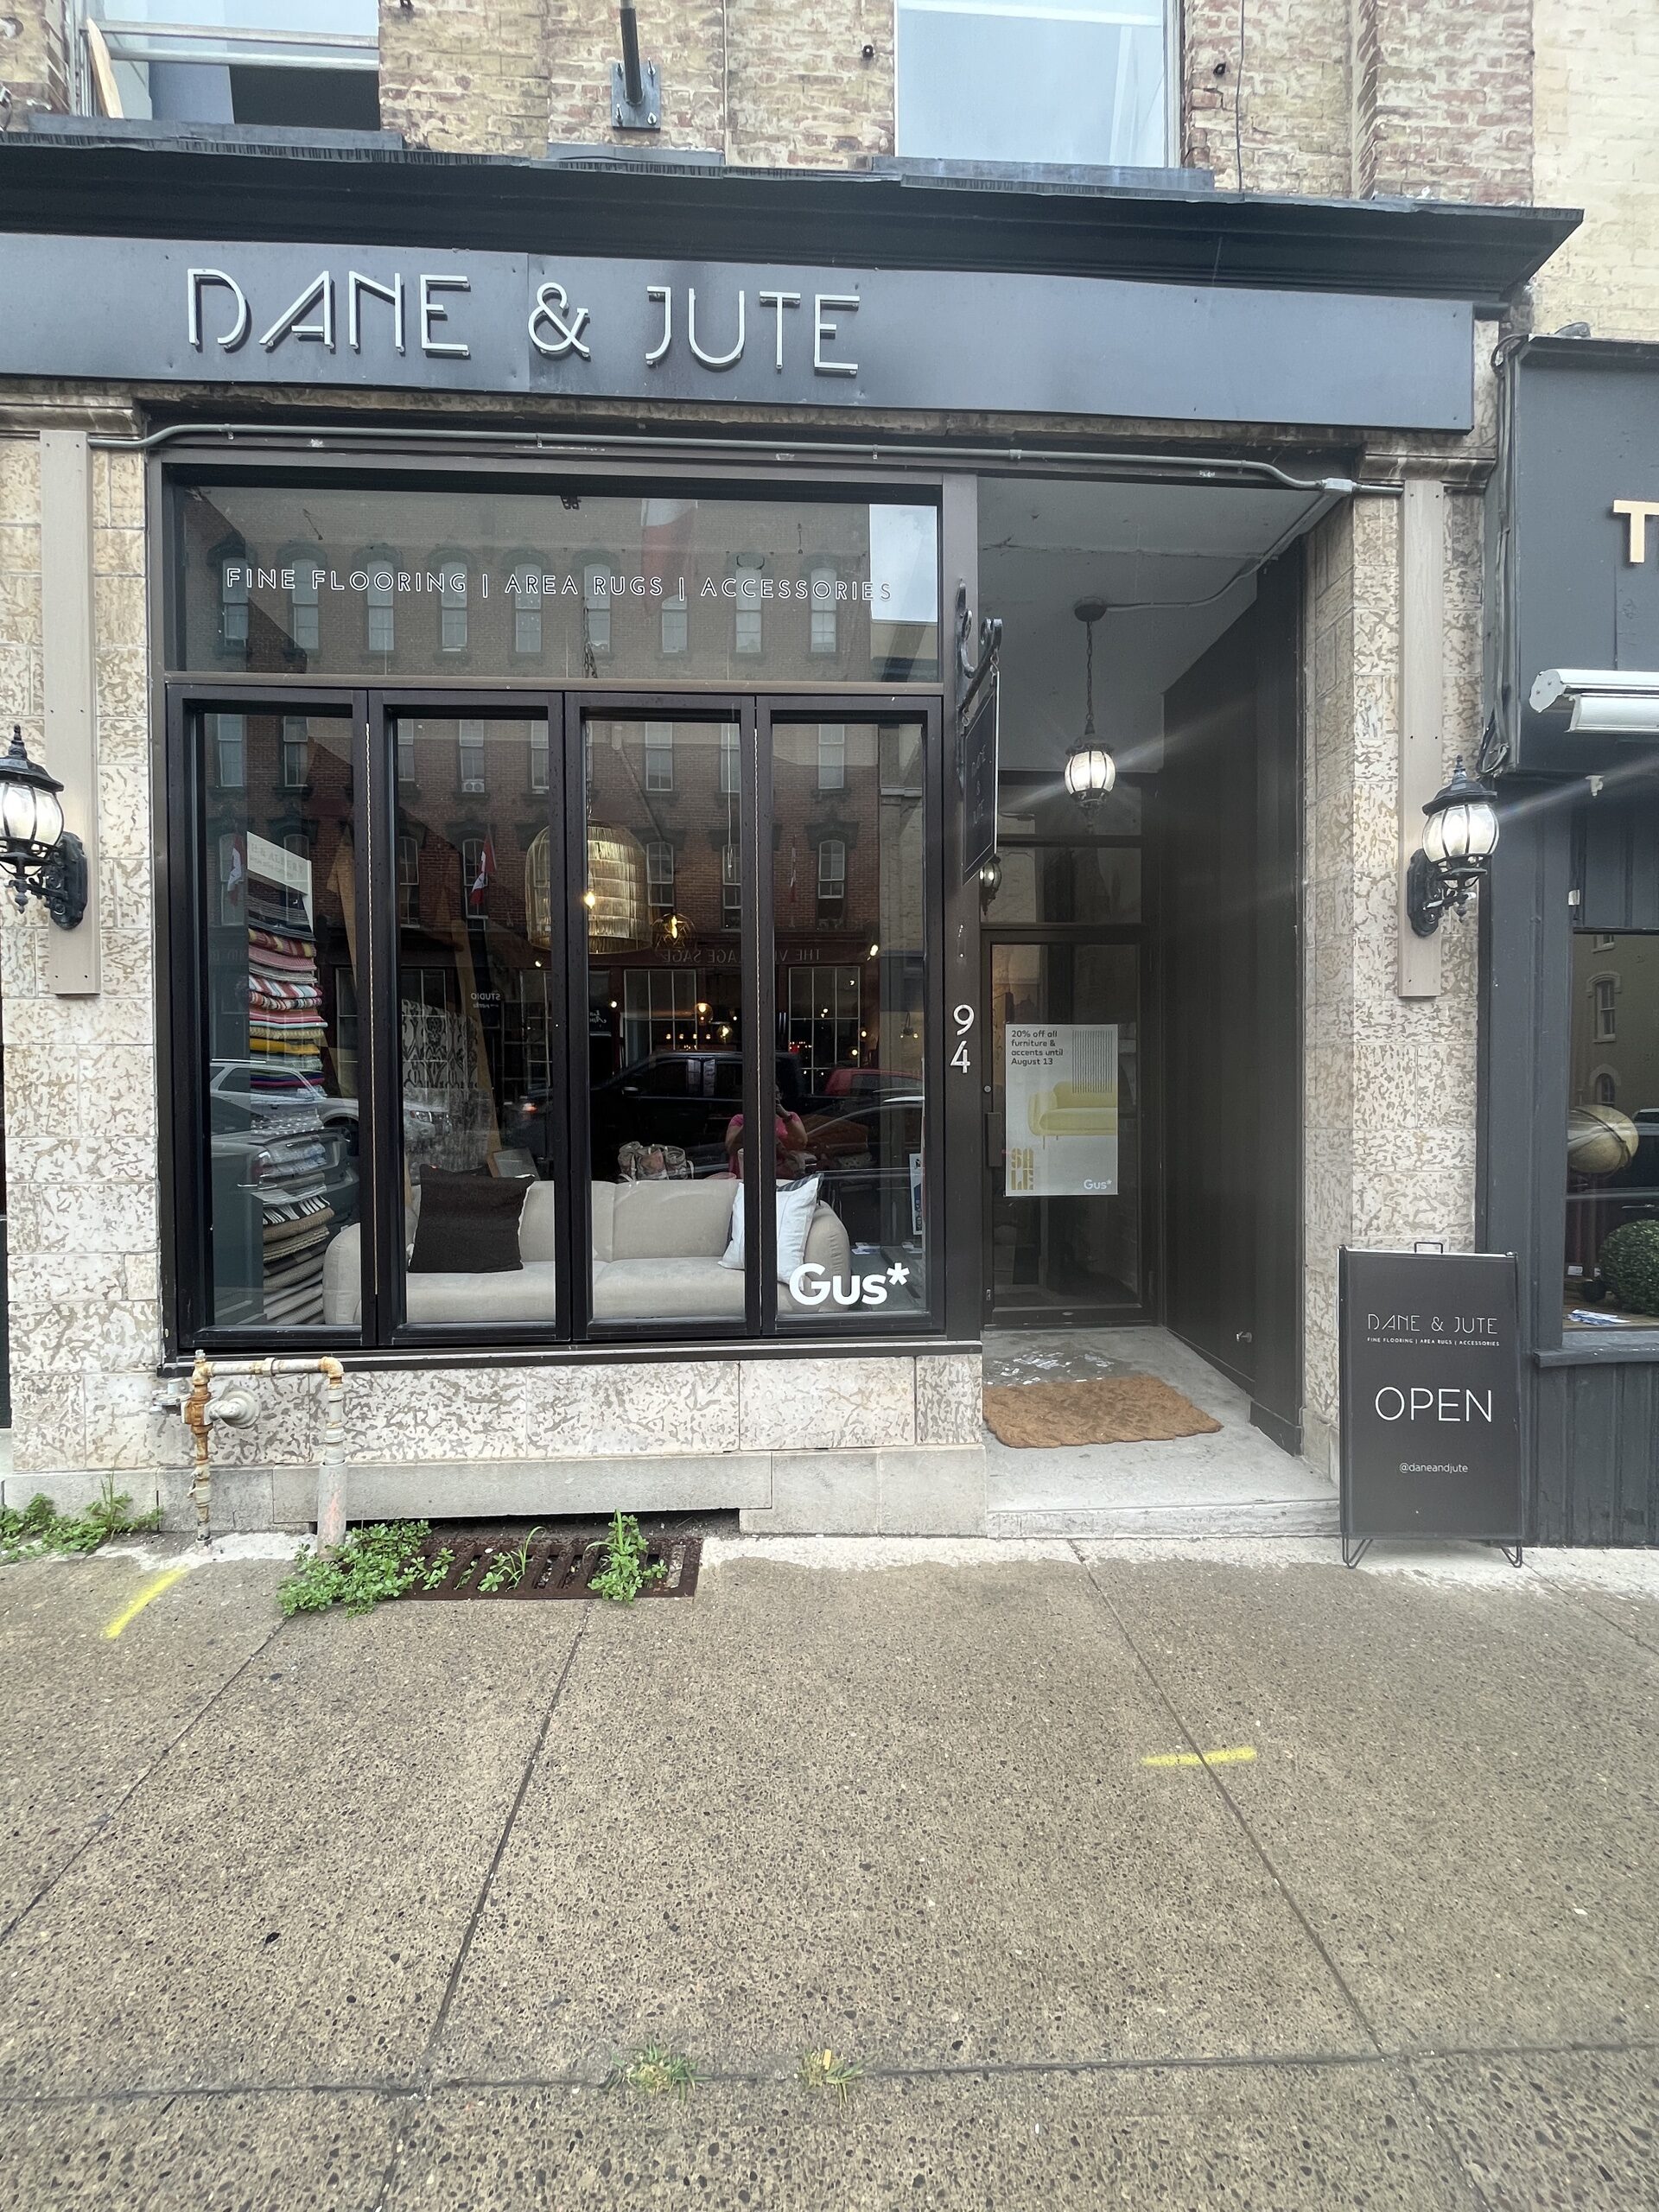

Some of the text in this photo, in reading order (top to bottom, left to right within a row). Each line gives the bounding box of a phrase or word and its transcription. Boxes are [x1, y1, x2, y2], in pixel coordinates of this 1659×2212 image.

[187, 268, 860, 375] DANE & JUTE
[226, 567, 296, 590] FINE
[312, 569, 467, 593] FLOORING
[505, 573, 578, 595] AREA
[593, 575, 663, 597] RUGS
[701, 576, 892, 601] ACCESSORIES
[1011, 1029, 1031, 1038] 20%
[1033, 1029, 1045, 1038] off
[1011, 1058, 1040, 1067] August
[1368, 1313, 1498, 1334] DANE & JUTE
[1375, 1386, 1493, 1422] OPEN
[1399, 1462, 1469, 1474] @daneandjute
